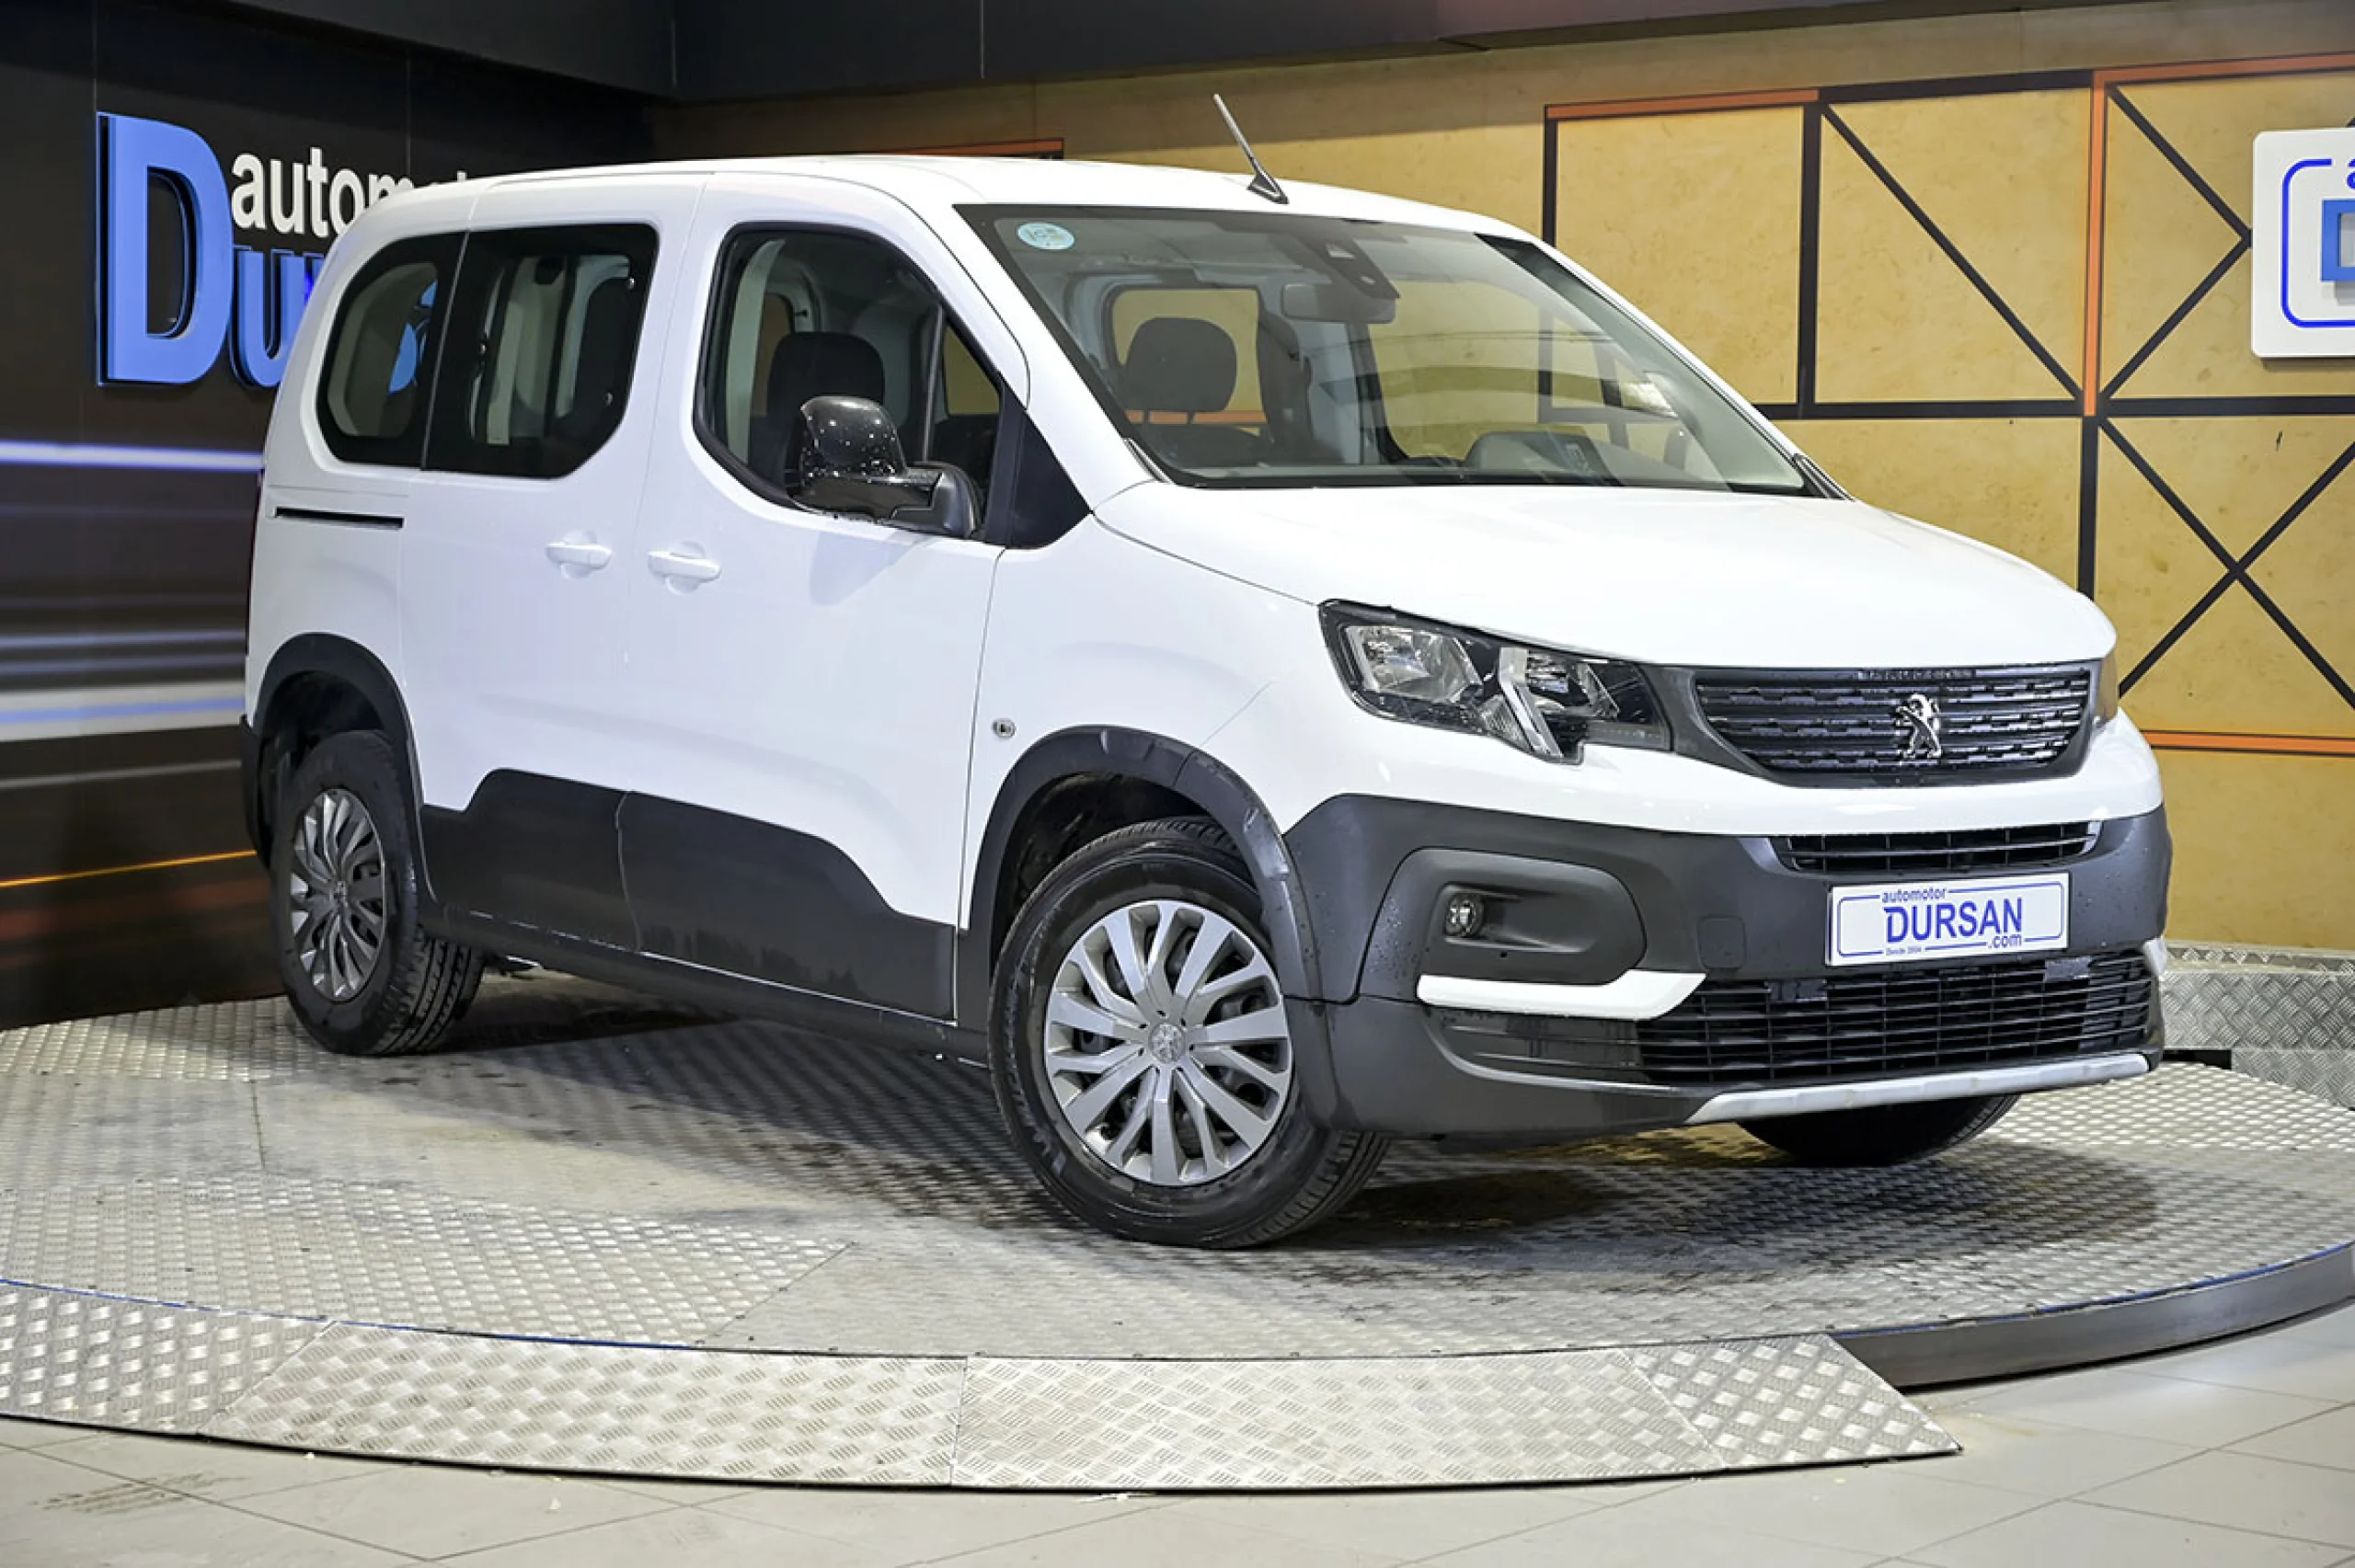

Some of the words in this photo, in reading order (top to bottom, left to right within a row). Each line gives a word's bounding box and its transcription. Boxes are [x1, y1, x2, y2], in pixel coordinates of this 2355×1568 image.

[96, 111, 325, 388] Du
[1881, 887, 1947, 903] automotor
[1883, 897, 2022, 943] DURSAN
[1987, 933, 2022, 949] .com
